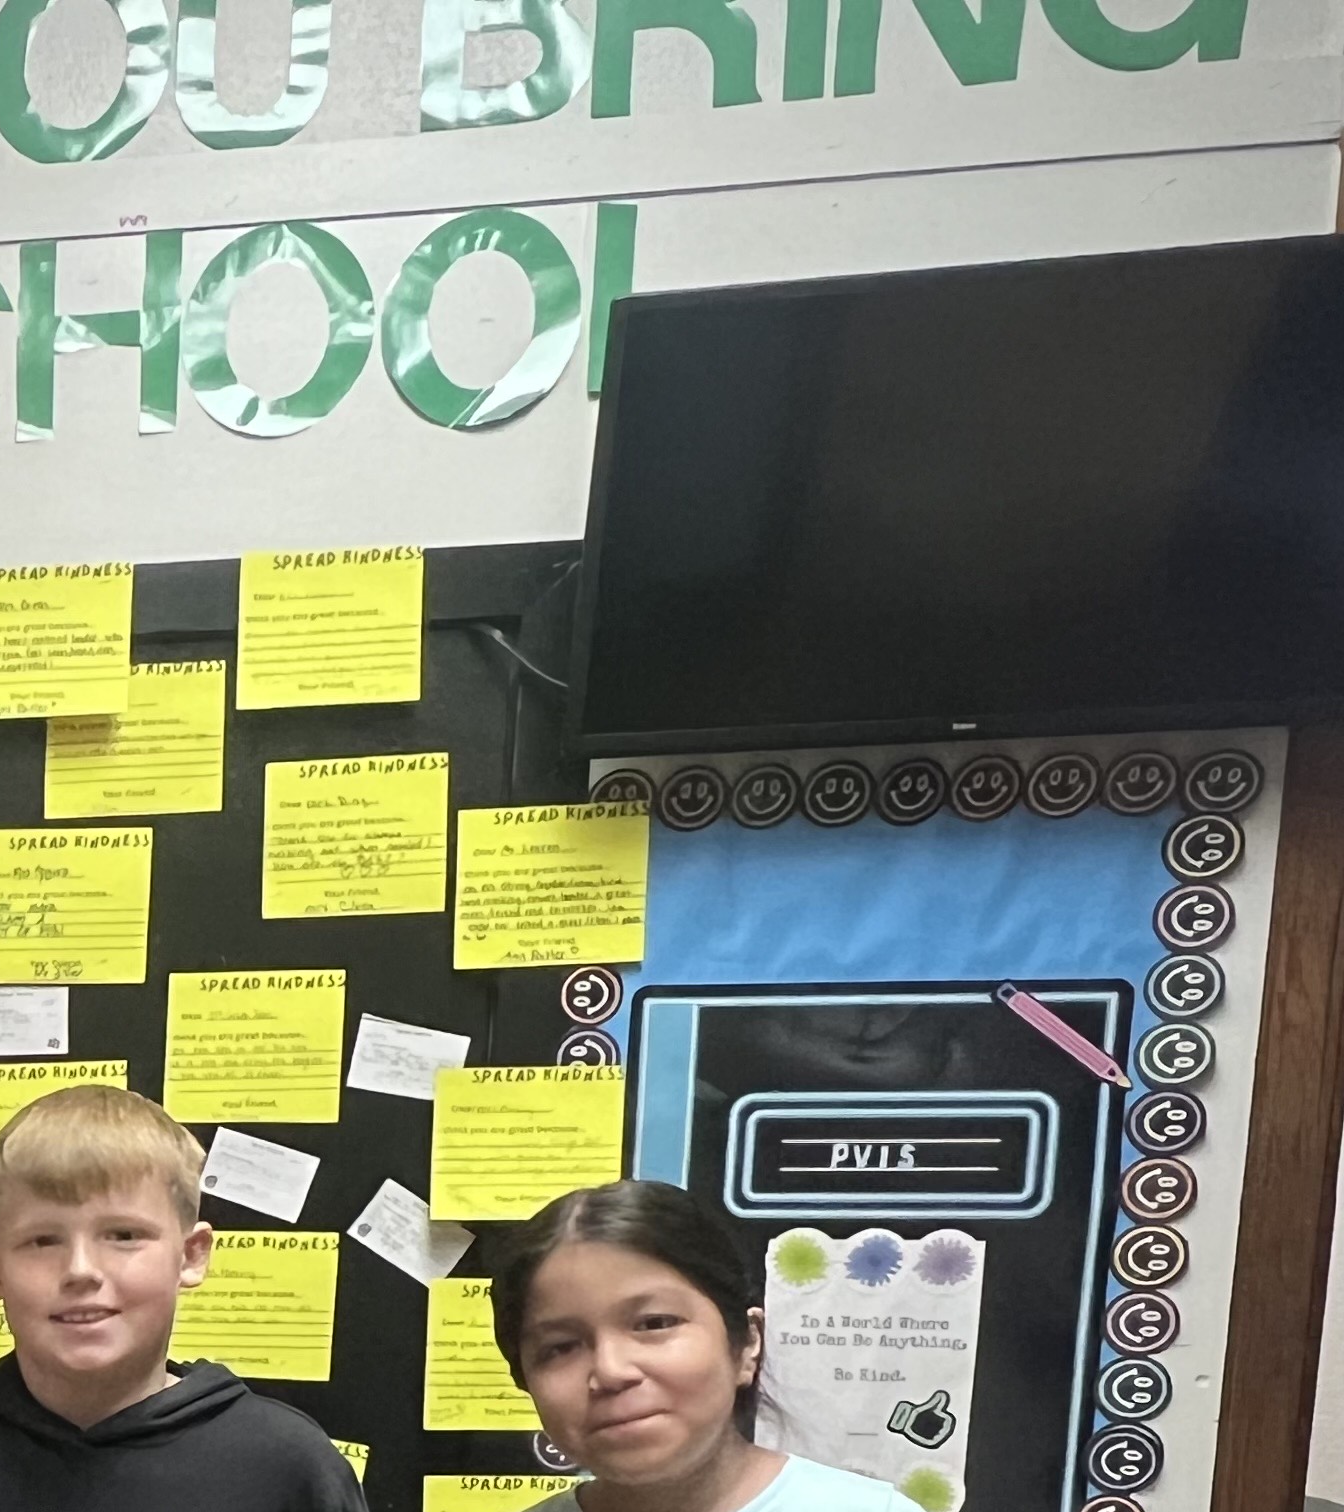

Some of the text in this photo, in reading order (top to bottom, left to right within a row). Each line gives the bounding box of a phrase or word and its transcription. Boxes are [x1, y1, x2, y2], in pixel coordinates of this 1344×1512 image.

[272, 551, 336, 571] SPREAD
[54, 562, 133, 580] KINDNESS
[299, 761, 361, 779] SPREAD
[493, 808, 560, 826] SPREAD
[8, 833, 151, 851] SPREAD KINDNESS
[199, 977, 262, 992] SPREAD
[471, 1067, 627, 1083] SPREAD KINDNESS
[830, 1142, 917, 1169] PVIS
[215, 1235, 257, 1250] READ
[842, 1315, 893, 1329] World
[899, 1317, 950, 1331] Where
[779, 1332, 810, 1345] You
[816, 1333, 846, 1346] Can
